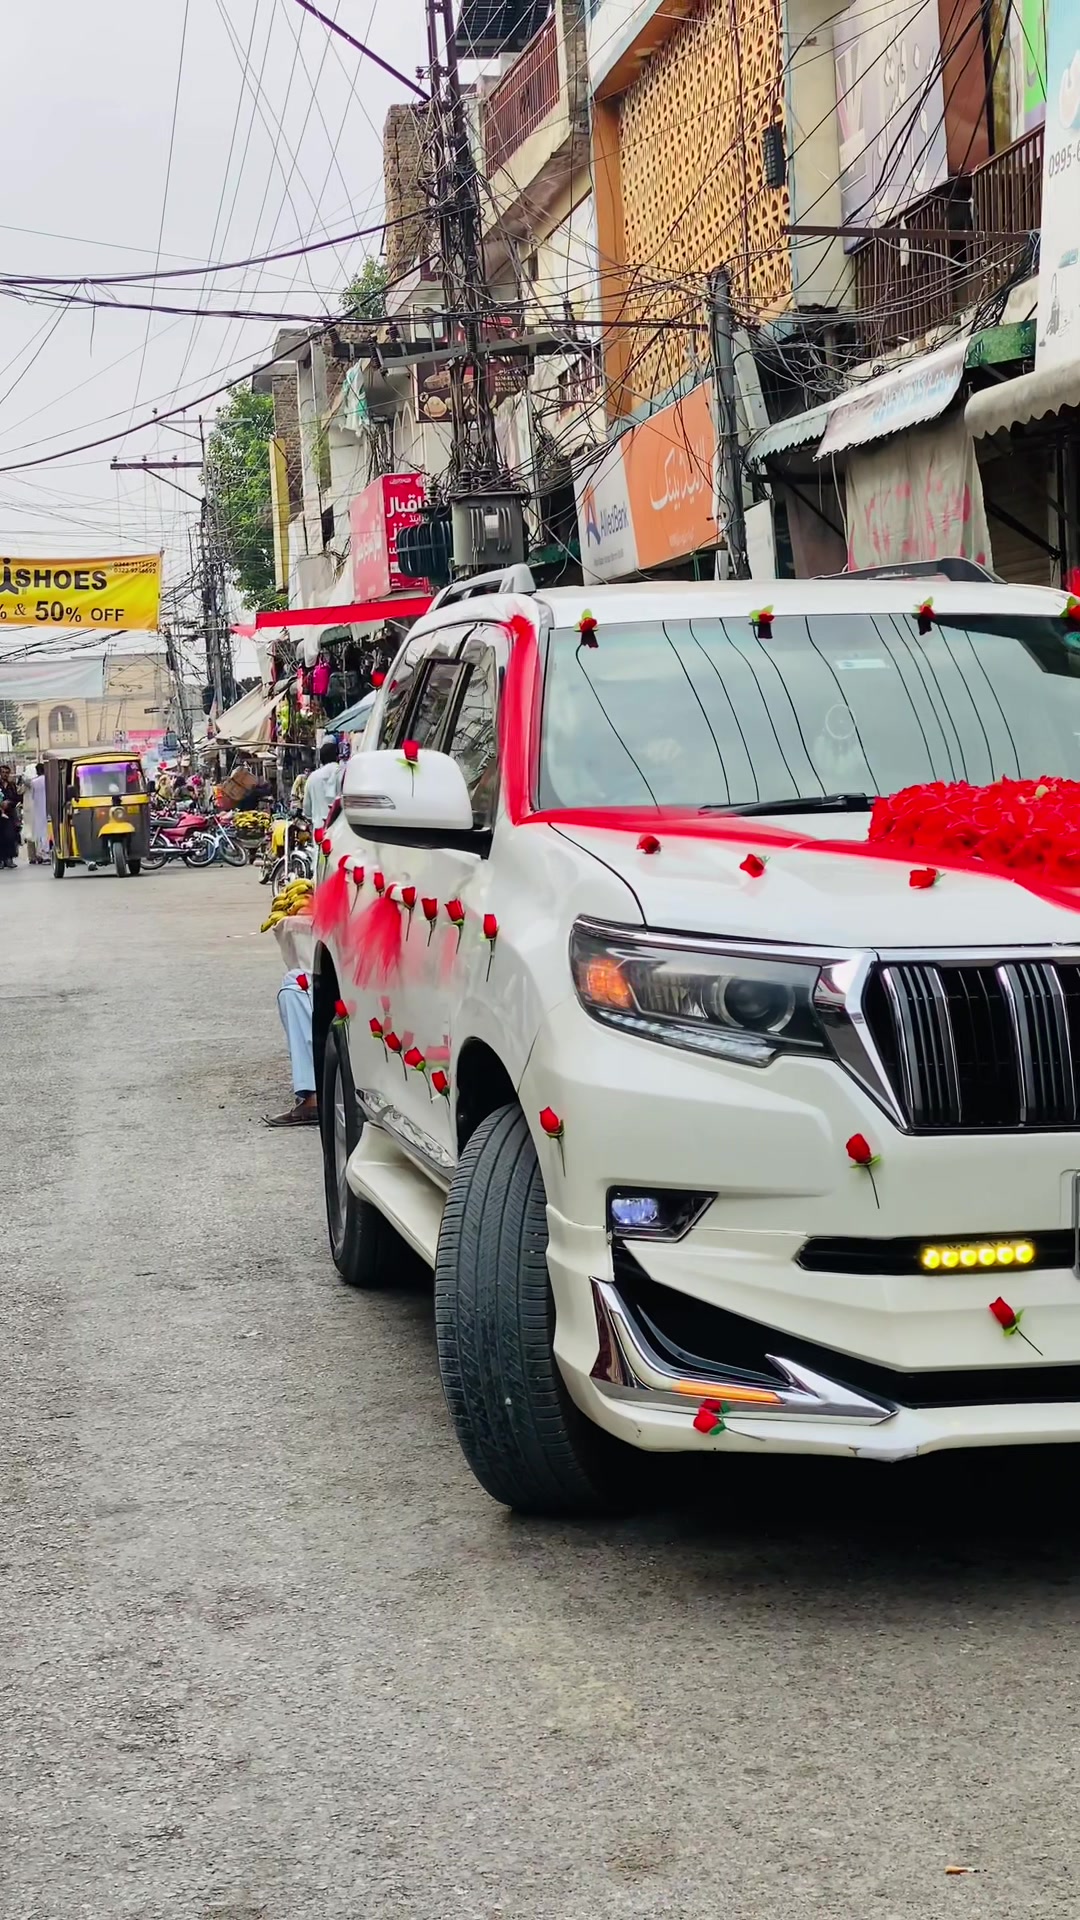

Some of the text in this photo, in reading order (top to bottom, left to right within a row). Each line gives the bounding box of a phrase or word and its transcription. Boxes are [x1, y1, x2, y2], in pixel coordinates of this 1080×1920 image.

[14, 603, 26, 616] &
[35, 600, 82, 622] 50%
[91, 608, 125, 622] OFF
